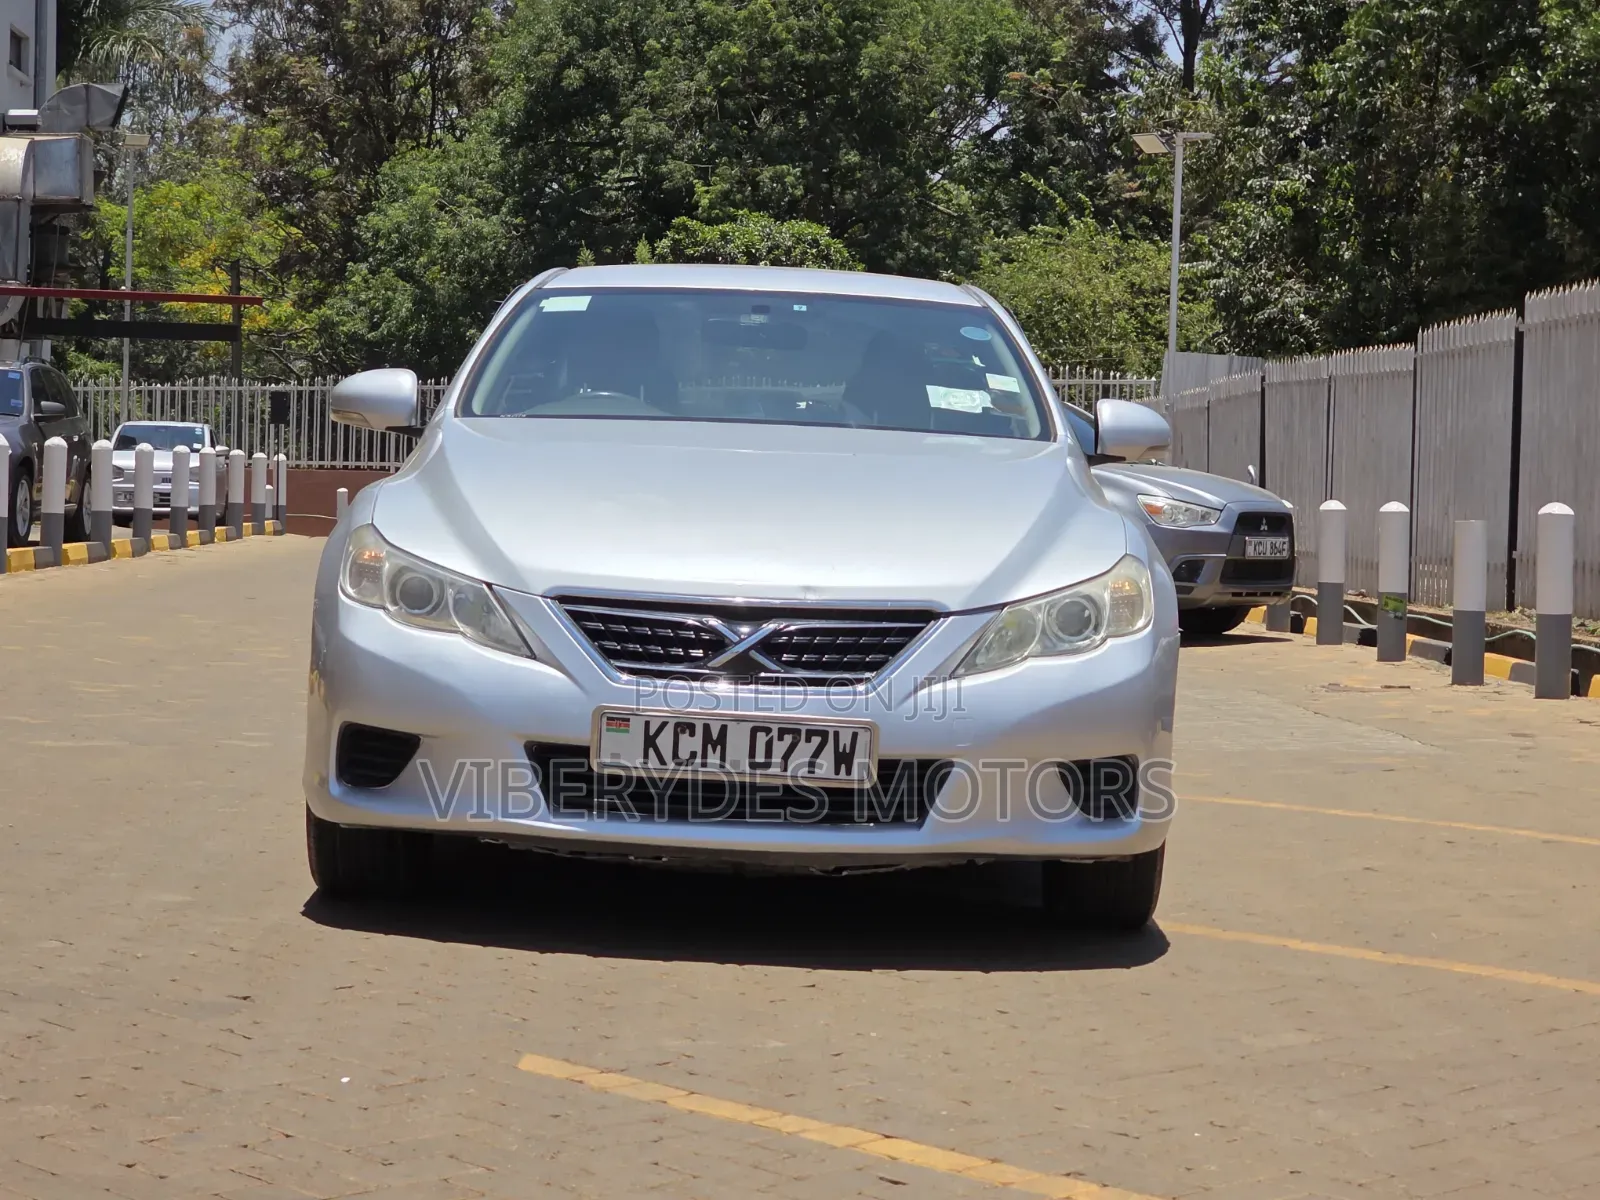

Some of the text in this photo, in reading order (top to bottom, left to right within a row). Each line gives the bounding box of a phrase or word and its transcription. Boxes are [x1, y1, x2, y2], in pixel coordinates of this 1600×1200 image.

[1253, 541, 1268, 556] KCU
[642, 719, 859, 777] KCM 077W
